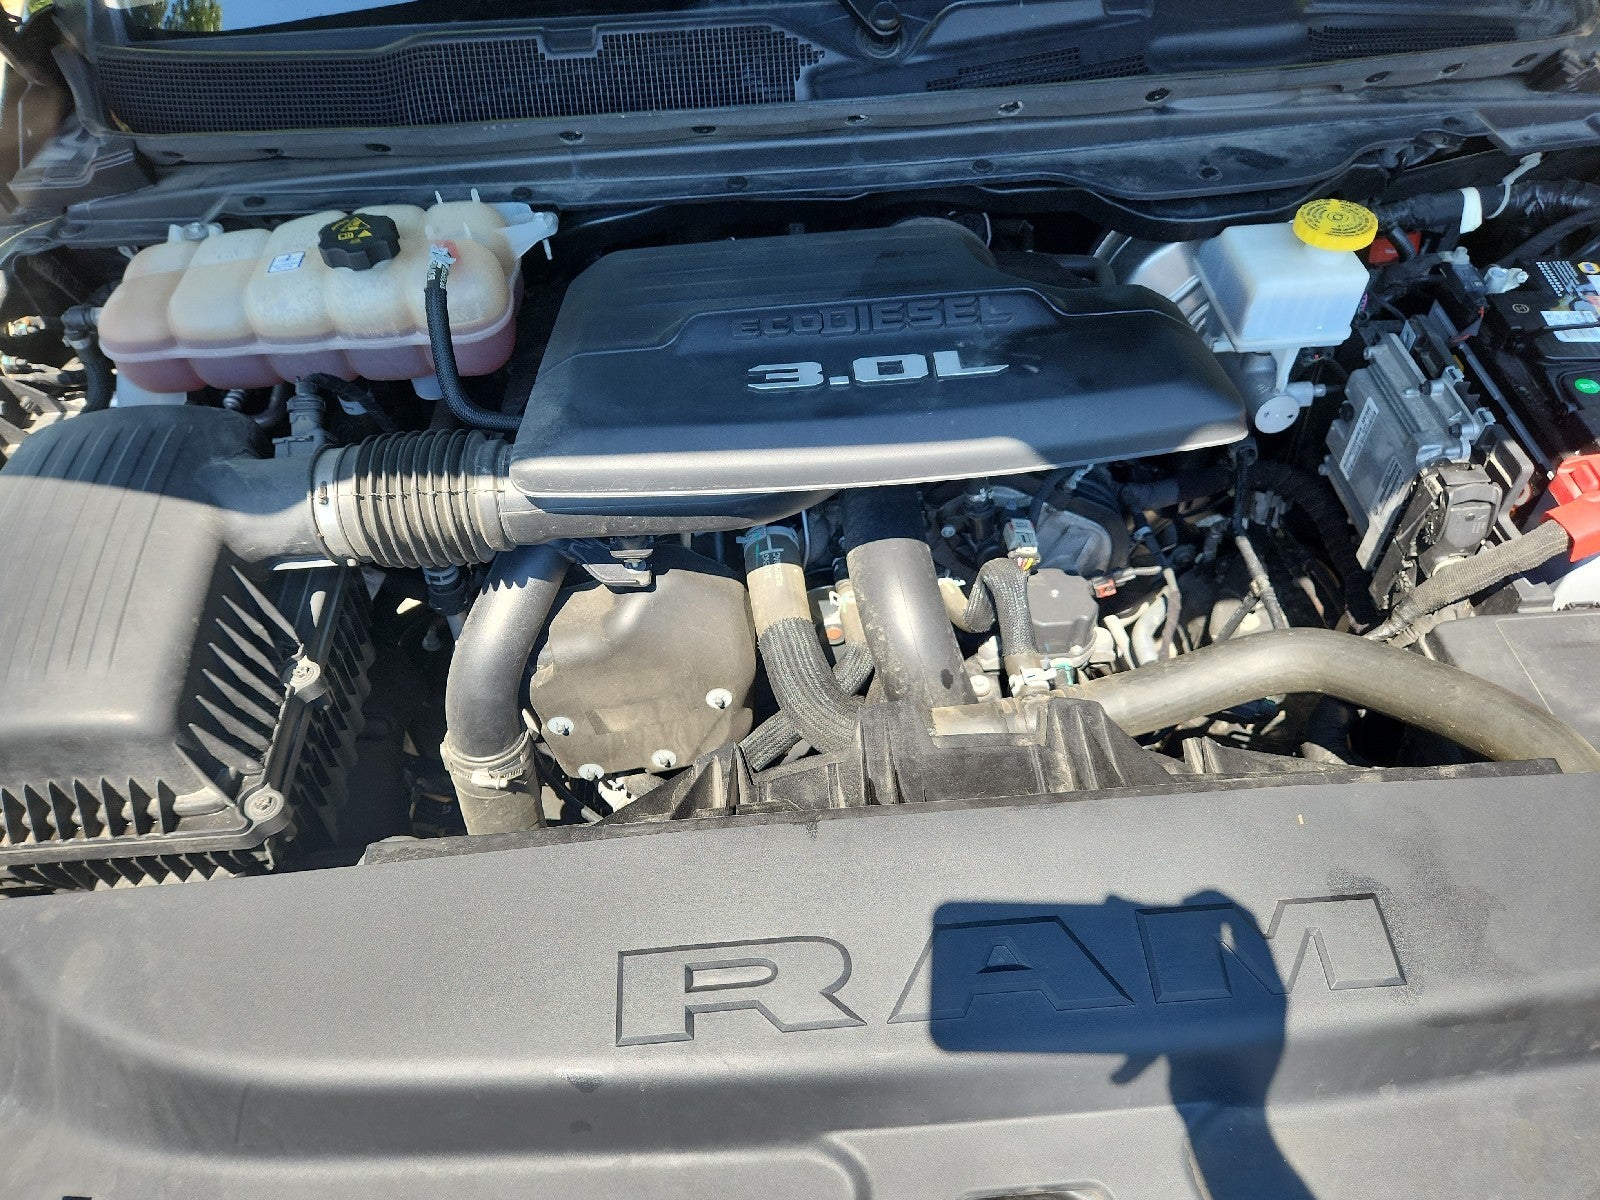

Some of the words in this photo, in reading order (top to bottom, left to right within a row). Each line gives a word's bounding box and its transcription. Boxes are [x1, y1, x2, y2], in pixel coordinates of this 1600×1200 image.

[730, 294, 1015, 340] ECODIESEL
[746, 350, 1010, 391] 3.0L
[615, 891, 1408, 1048] RAM
